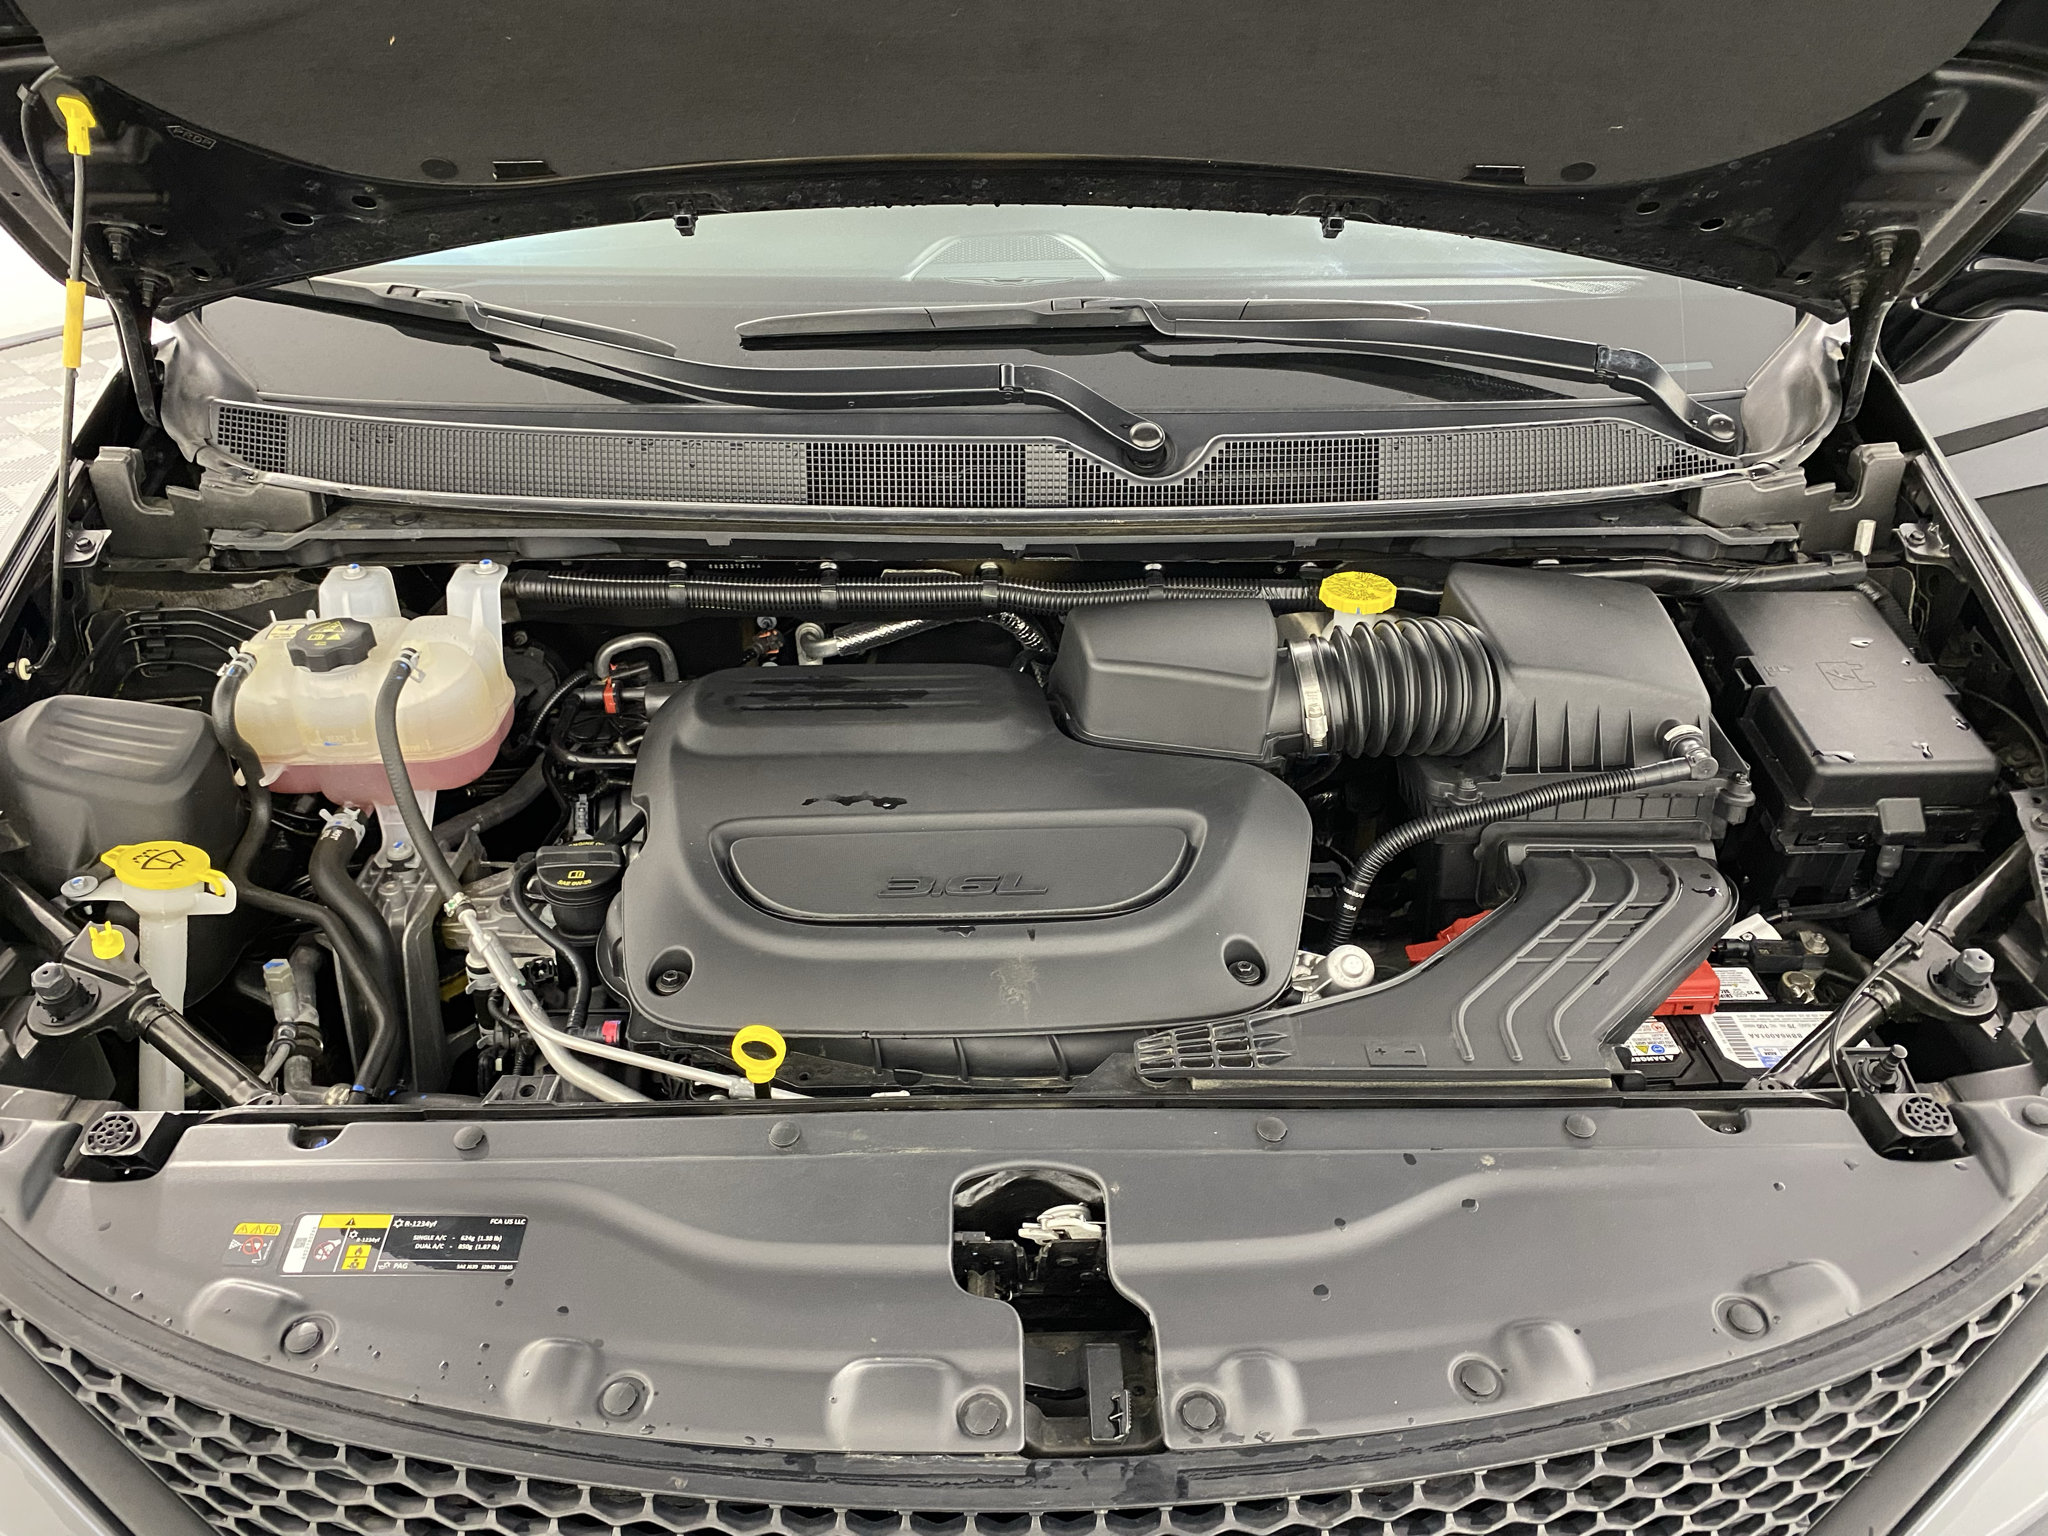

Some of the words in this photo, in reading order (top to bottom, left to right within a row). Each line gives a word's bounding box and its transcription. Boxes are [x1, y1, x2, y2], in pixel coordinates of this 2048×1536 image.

[876, 873, 1049, 899] 3.6L
[404, 1220, 438, 1229] R-1234yf
[435, 1234, 448, 1242] A/C
